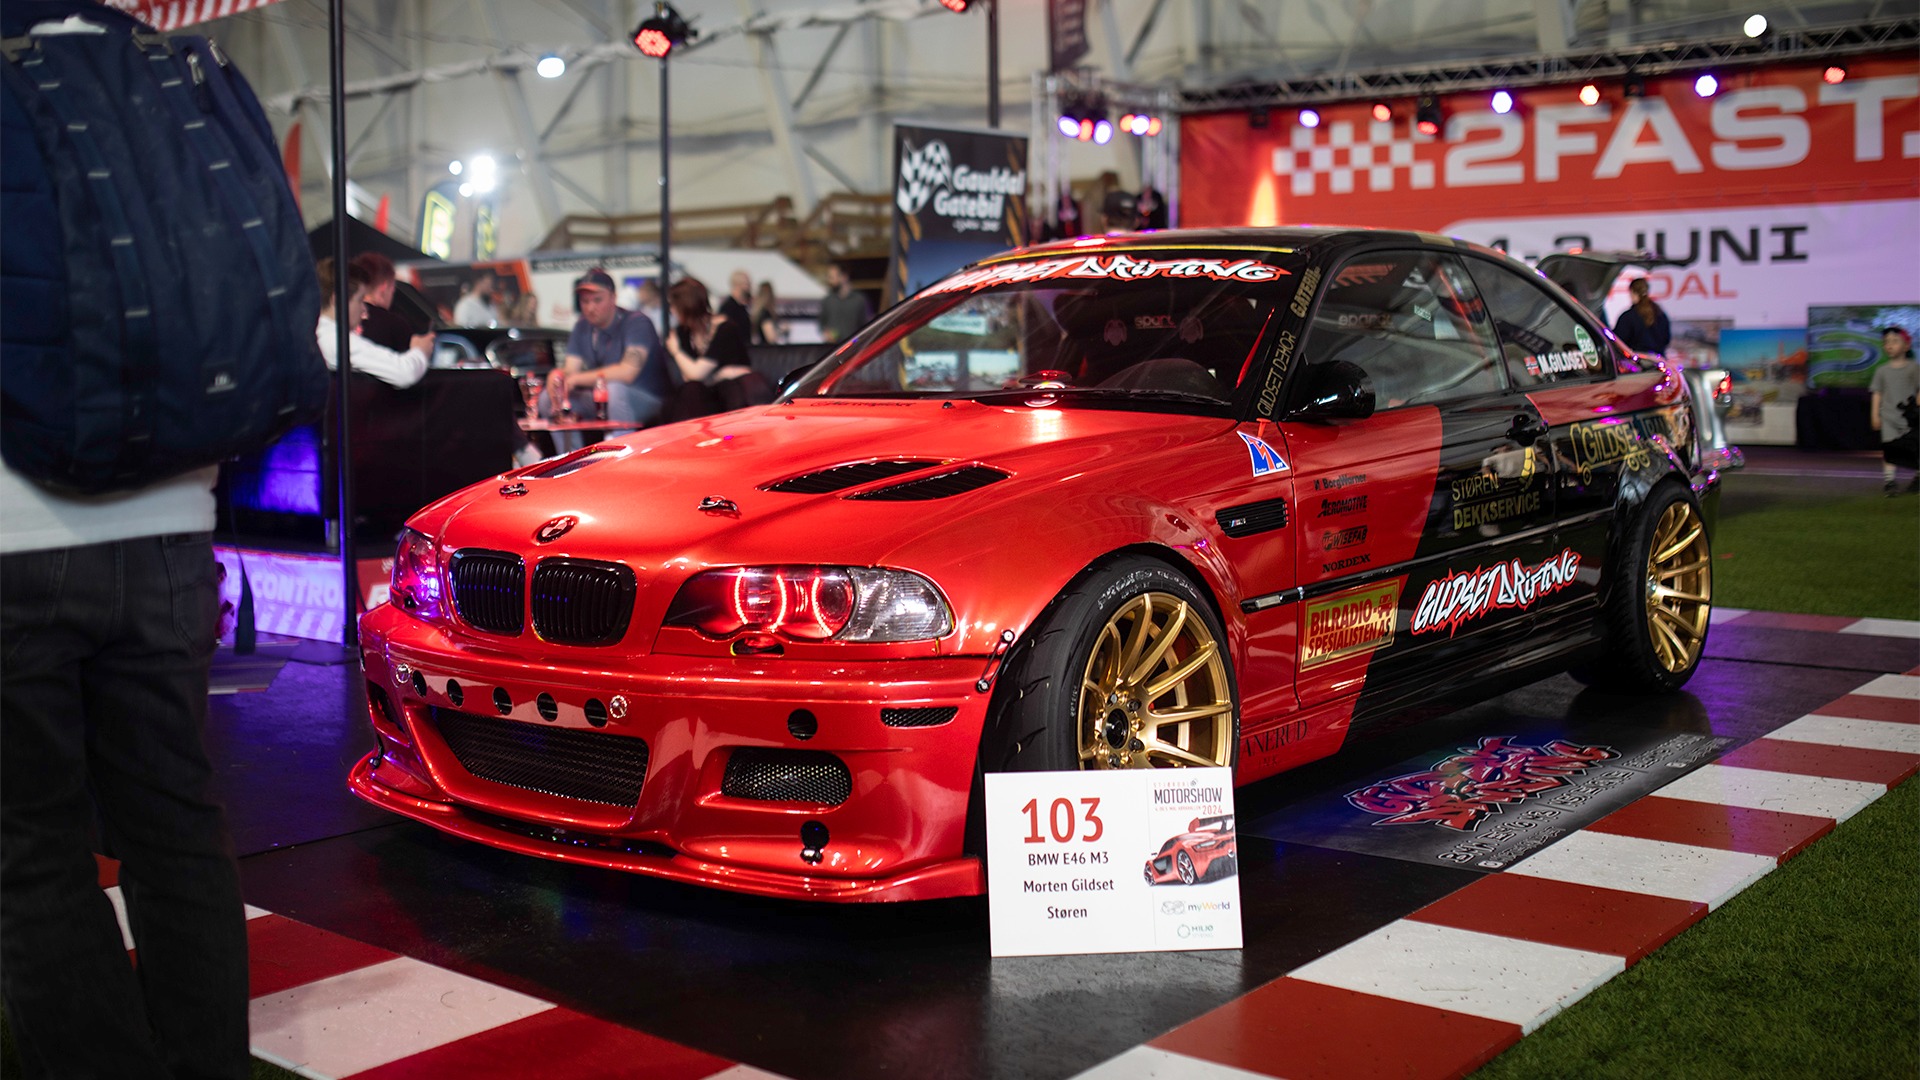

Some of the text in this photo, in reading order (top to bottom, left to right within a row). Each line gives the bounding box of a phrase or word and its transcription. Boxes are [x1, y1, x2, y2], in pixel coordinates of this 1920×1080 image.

[933, 189, 1005, 218] Gatebil
[1257, 367, 1284, 417] GILDSET
[1322, 474, 1367, 489] BorgWarner
[1452, 472, 1499, 501] STØREN
[1317, 495, 1368, 518] AEROMOTIVE
[1454, 491, 1540, 530] DEKKSERVICE
[1333, 527, 1368, 548] WISEFAB
[1413, 550, 1578, 631] GILDSET DRIFTING
[1308, 621, 1379, 659] SPESIALISTEN
[1154, 787, 1222, 804] MOTORSHOW
[1021, 797, 1104, 844] 103
[1202, 804, 1223, 815] 2024
[1028, 851, 1109, 866] BMW E46 M3
[1023, 878, 1114, 893] Morten Gildset
[1047, 906, 1087, 919] Støren
[1187, 901, 1231, 912] myWorld
